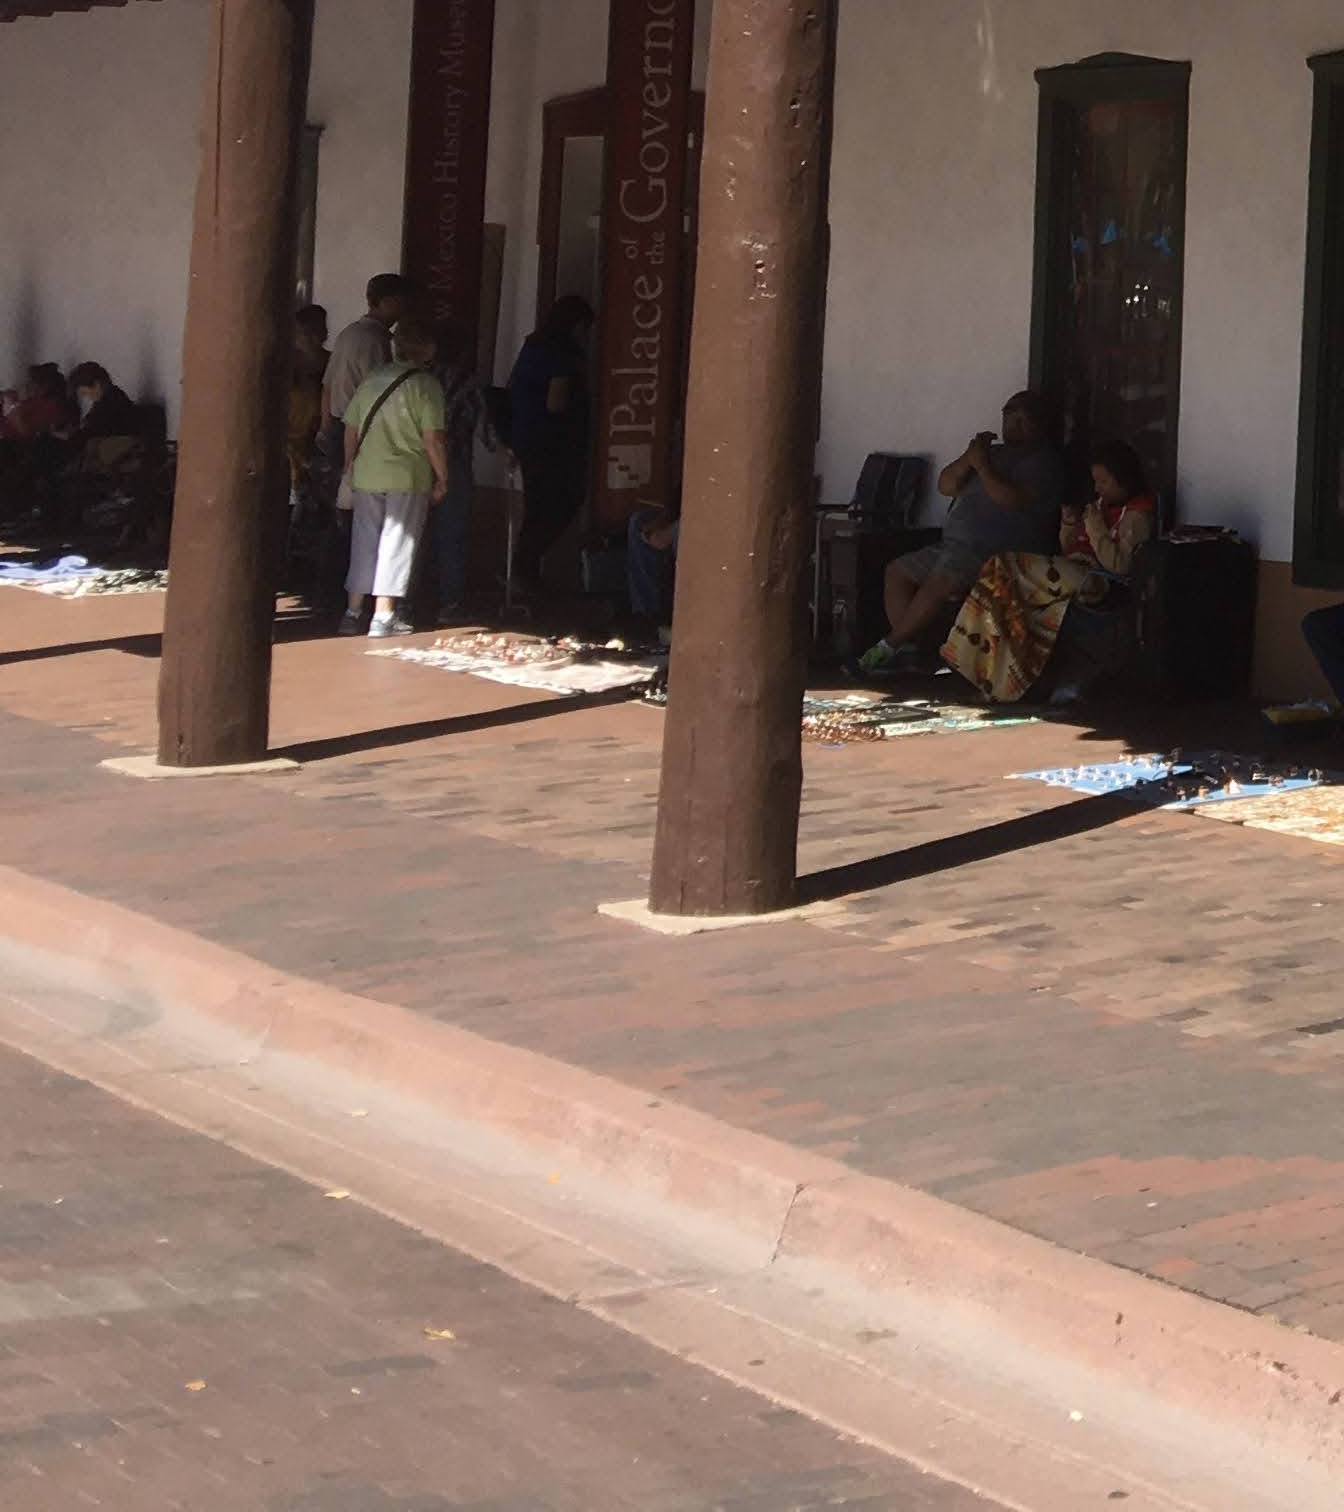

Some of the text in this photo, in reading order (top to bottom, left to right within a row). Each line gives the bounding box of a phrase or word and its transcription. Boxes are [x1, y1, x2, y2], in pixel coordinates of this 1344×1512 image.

[433, 84, 468, 184] History
[428, 192, 456, 295] Mexico
[619, 235, 640, 260] of
[644, 231, 666, 265] the
[609, 274, 664, 437] Palace
